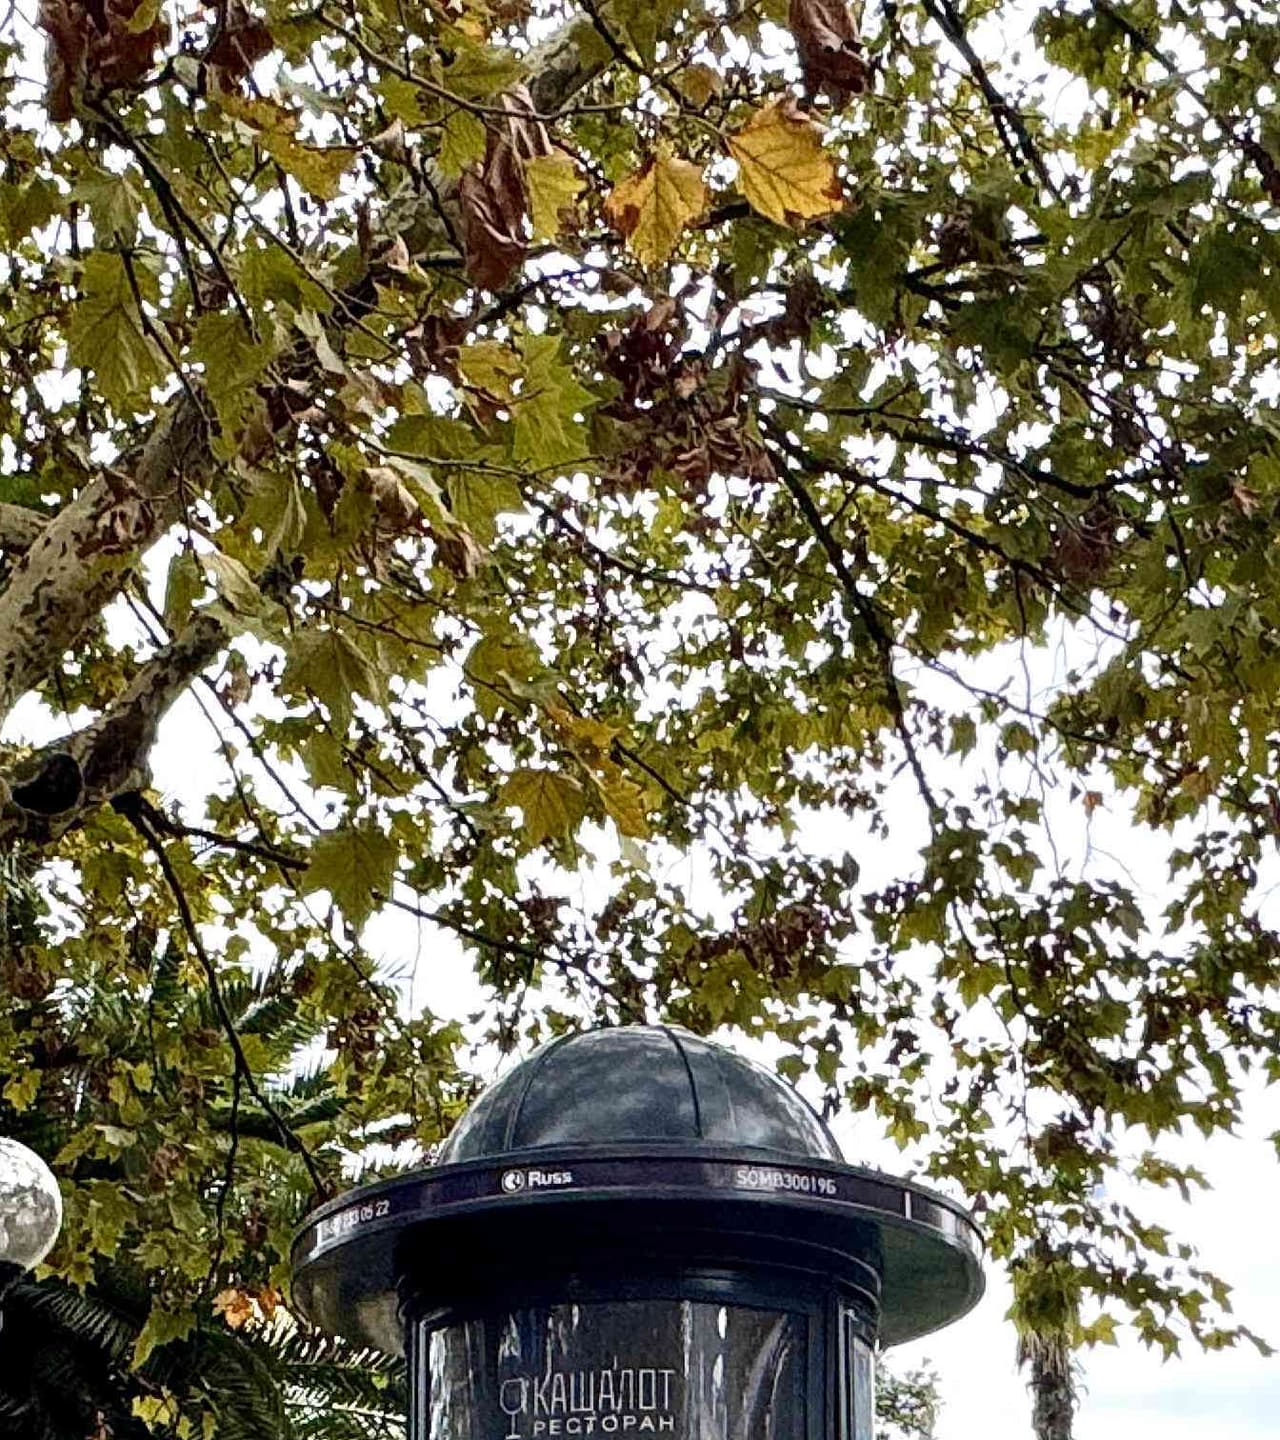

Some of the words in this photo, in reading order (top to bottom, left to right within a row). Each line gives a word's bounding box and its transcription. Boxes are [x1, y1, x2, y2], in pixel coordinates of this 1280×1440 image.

[528, 1171, 573, 1187] Russ
[533, 1368, 676, 1415] КАШАЛОТ
[533, 1414, 676, 1437] РЕСТОРАН
